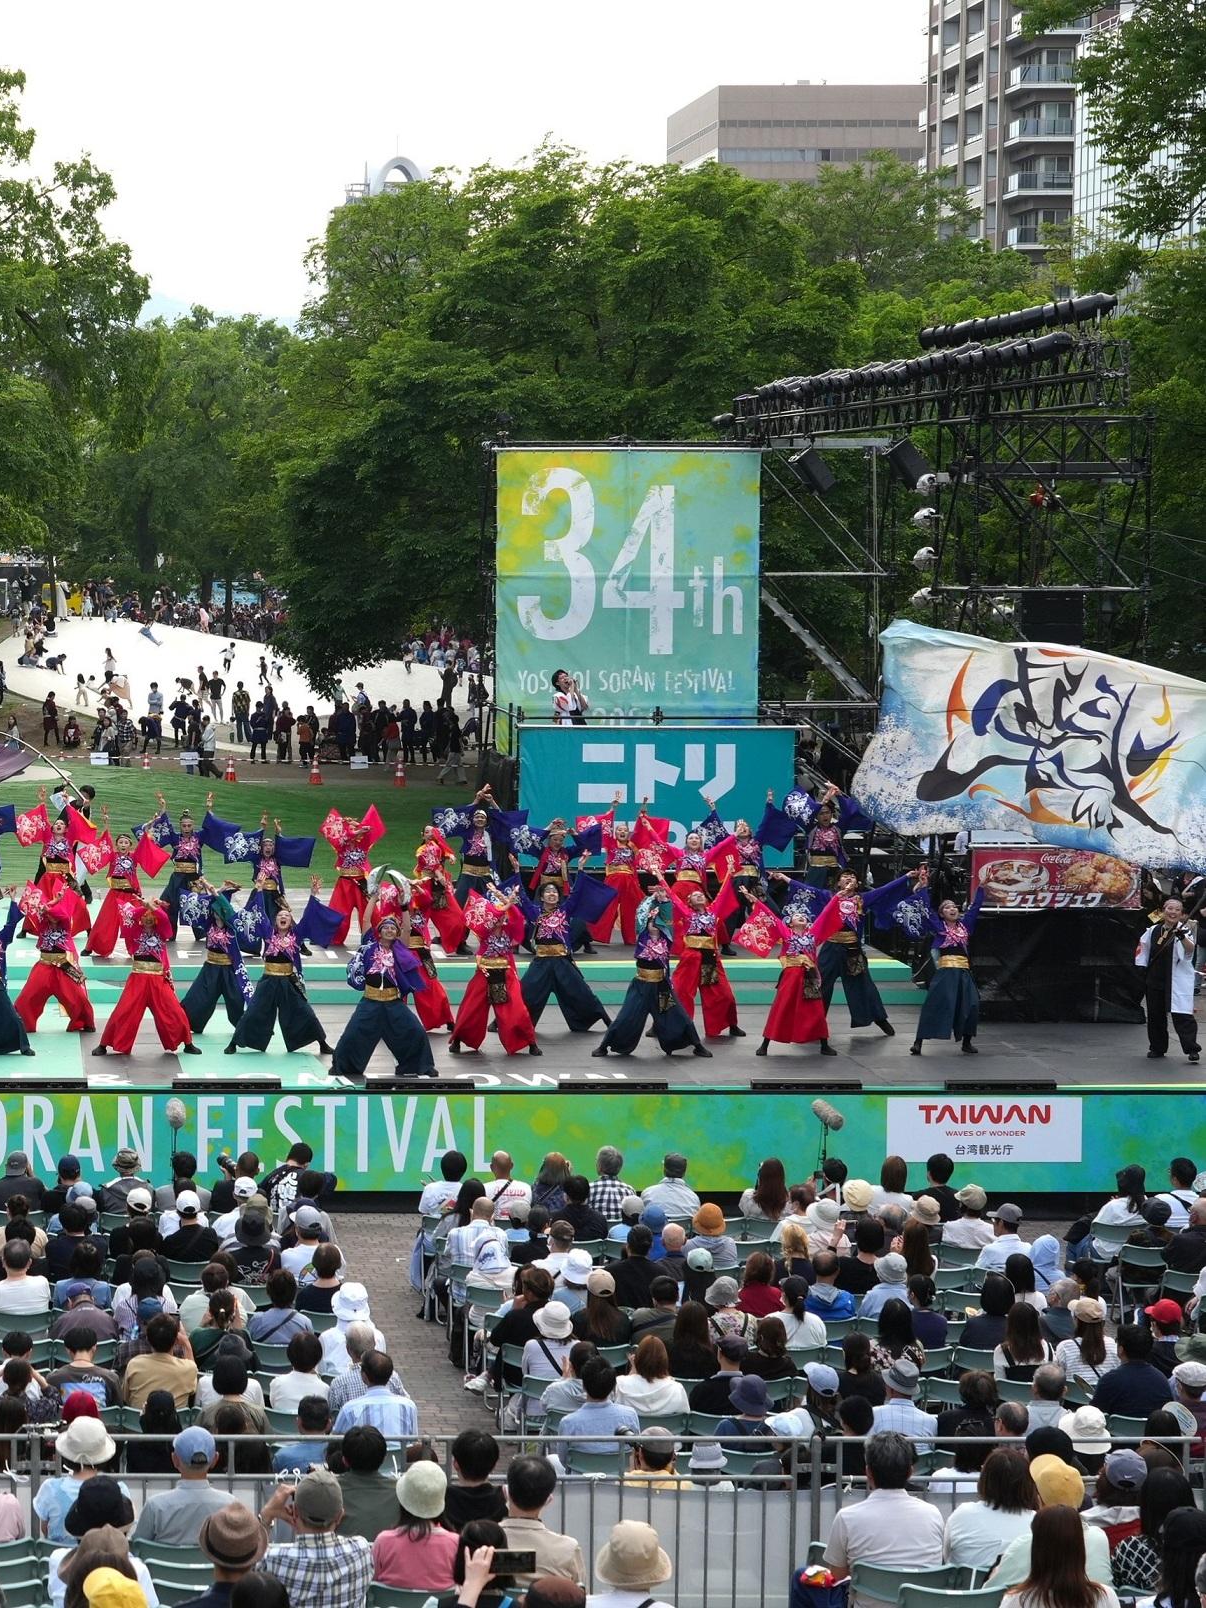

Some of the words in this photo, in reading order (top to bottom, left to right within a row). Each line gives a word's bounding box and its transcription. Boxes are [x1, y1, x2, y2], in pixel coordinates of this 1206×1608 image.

[517, 467, 743, 655] 34th
[517, 669, 591, 695] YOSOI
[598, 665, 656, 693] SORAN
[664, 667, 735, 694] FESTIVAL
[578, 743, 736, 804] ニトリ
[196, 1094, 493, 1173] FESTIVAL
[918, 1104, 1051, 1124] TAIWAN
[954, 1144, 1014, 1156] 台湾観光庁
